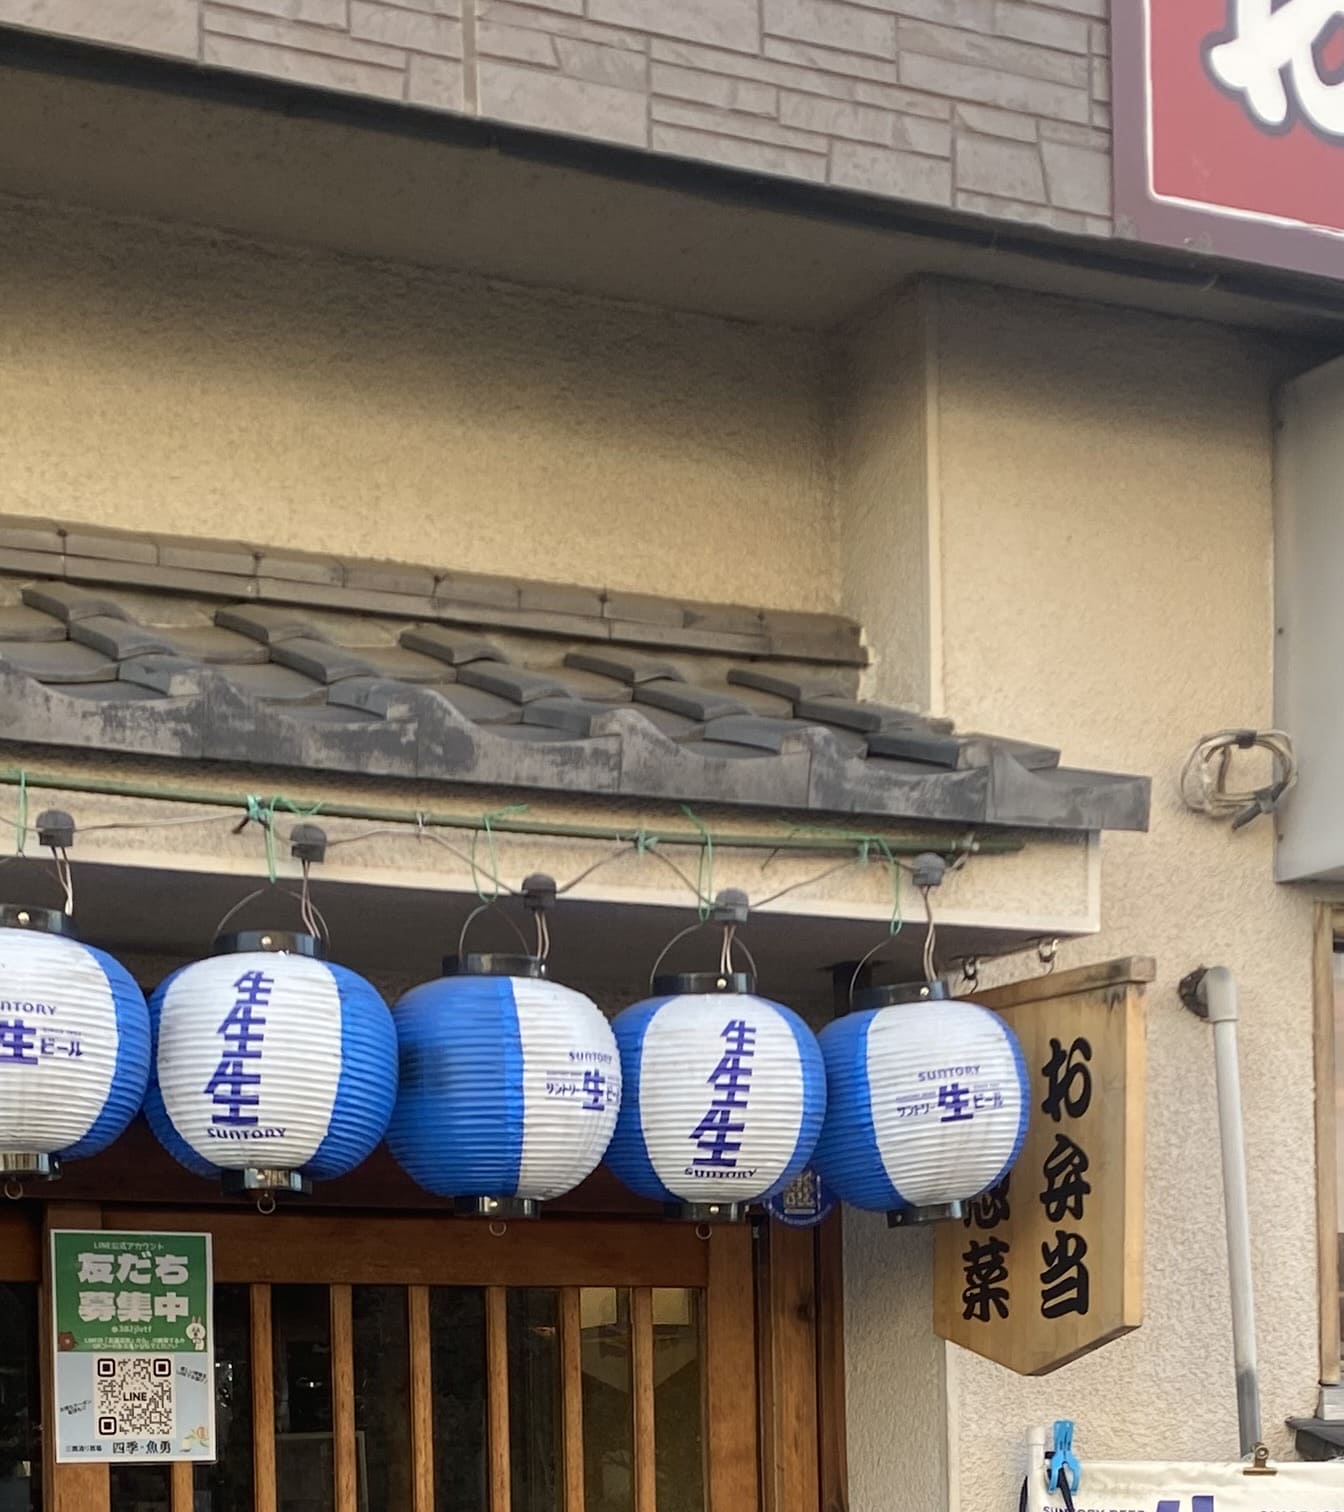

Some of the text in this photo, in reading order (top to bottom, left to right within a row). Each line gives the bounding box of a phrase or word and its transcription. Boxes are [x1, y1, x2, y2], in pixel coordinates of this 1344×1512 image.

[203, 970, 274, 1125] 生生生
[917, 1064, 981, 1082] SUNTORY
[688, 1019, 757, 1167] 生生生
[207, 1127, 286, 1140] SUNTORY
[1039, 1037, 1092, 1320] お弁当
[77, 1250, 189, 1285] 友だち
[77, 1290, 189, 1323] 募集中
[122, 1391, 148, 1402] LINE
